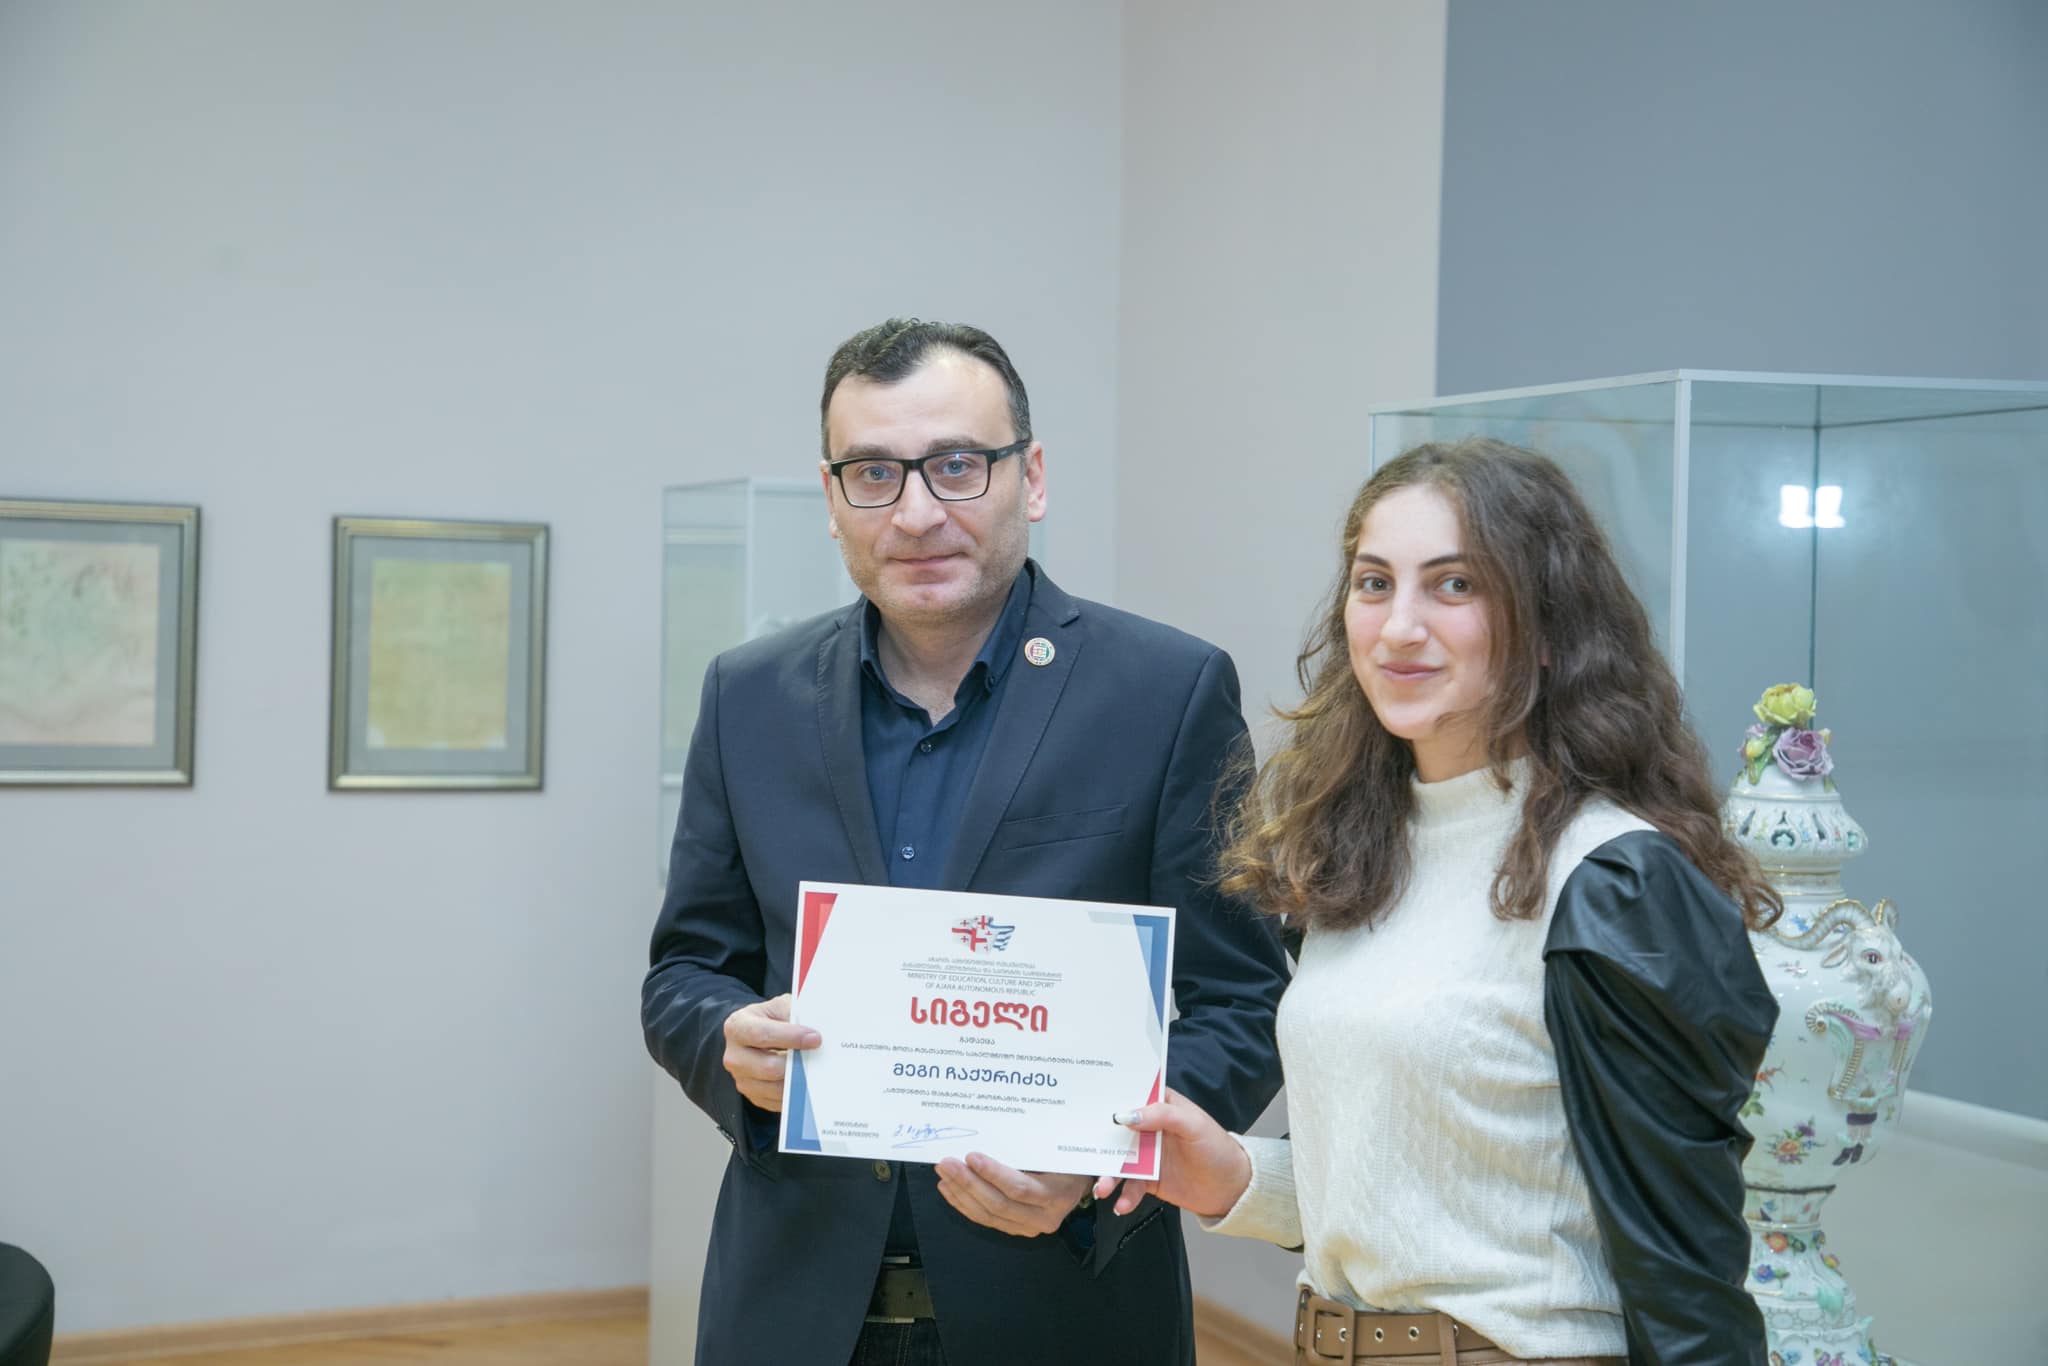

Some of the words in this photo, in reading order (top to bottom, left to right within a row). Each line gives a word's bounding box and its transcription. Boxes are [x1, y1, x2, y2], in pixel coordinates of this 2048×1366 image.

[935, 982, 956, 990] AJARA
[957, 984, 1004, 993] AUTONOMOUS
[1005, 987, 1035, 996] REPUBLIC
[988, 977, 1016, 985] CULTURE
[1034, 980, 1054, 988] SPORT
[910, 995, 1048, 1033] სიგელი
[959, 1035, 995, 1045] გადაეცა
[893, 1062, 940, 1079] მეგი
[945, 1066, 1057, 1087] ჩაქურიძეს
